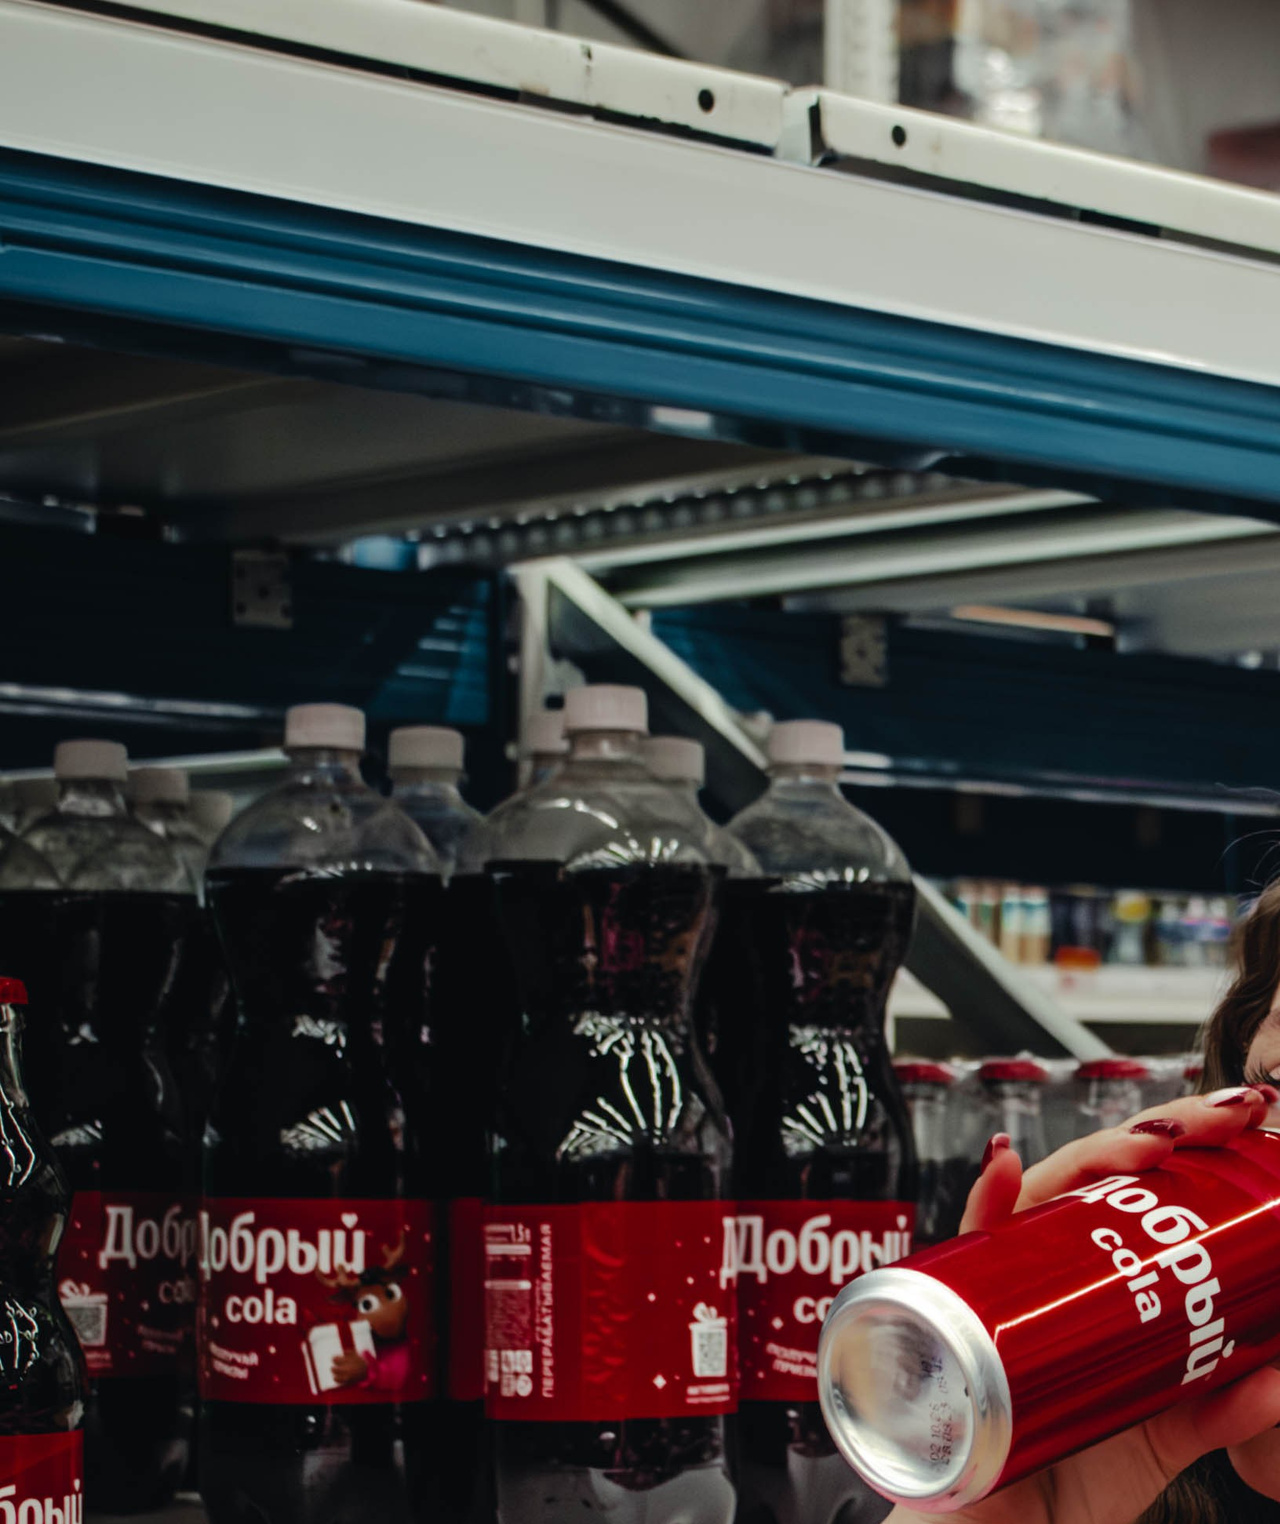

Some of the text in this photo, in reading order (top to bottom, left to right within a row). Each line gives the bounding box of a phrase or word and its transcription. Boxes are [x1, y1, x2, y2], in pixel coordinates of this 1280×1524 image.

[225, 1289, 297, 1325] cola
[1052, 1175, 1236, 1386] Добрый
[1091, 1227, 1162, 1324] cola
